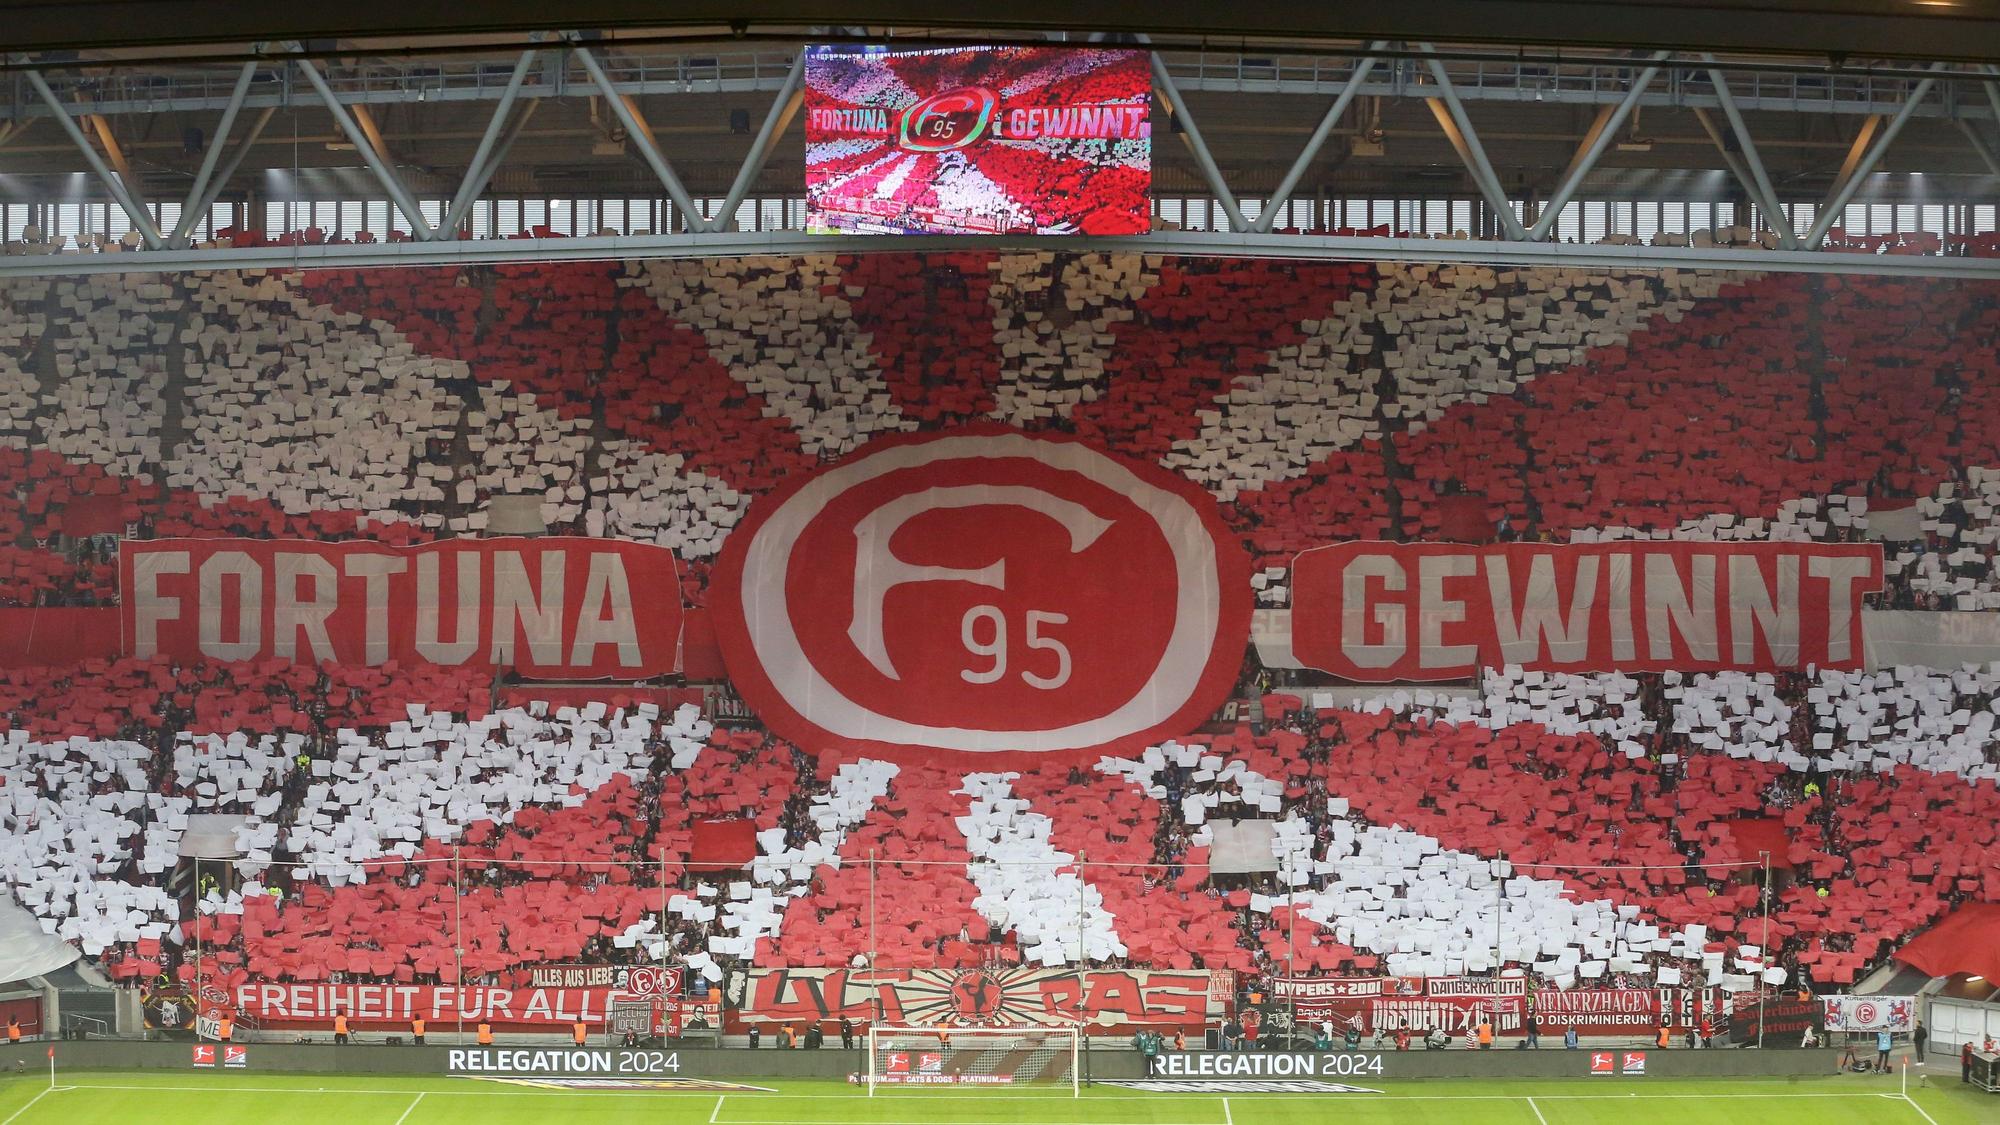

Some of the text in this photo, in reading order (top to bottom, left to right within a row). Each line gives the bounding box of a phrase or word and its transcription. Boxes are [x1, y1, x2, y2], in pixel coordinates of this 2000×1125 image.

[812, 108, 888, 133] FORTUNA
[930, 119, 955, 139] 95
[1010, 107, 1144, 138] GEWINNT
[133, 550, 643, 667] FORTUNA
[1341, 553, 1872, 669] GEWINNT
[960, 604, 1073, 690] 95
[532, 966, 613, 987] ALLES AUS LIEBE
[237, 984, 420, 1018] FREIHEIT
[432, 987, 514, 1019] FÜR
[1275, 981, 1381, 998] HYPERS 2001
[1535, 990, 1651, 1014] MEINERZHAGEN
[449, 1050, 680, 1072] RELEGATION 2024
[1150, 1054, 1383, 1075] RELEGATION 2024
[906, 1075, 926, 1083] CATS
[928, 1075, 933, 1083] &
[935, 1075, 953, 1083] DOGS
[960, 1075, 1012, 1083] PLATINUM.com
